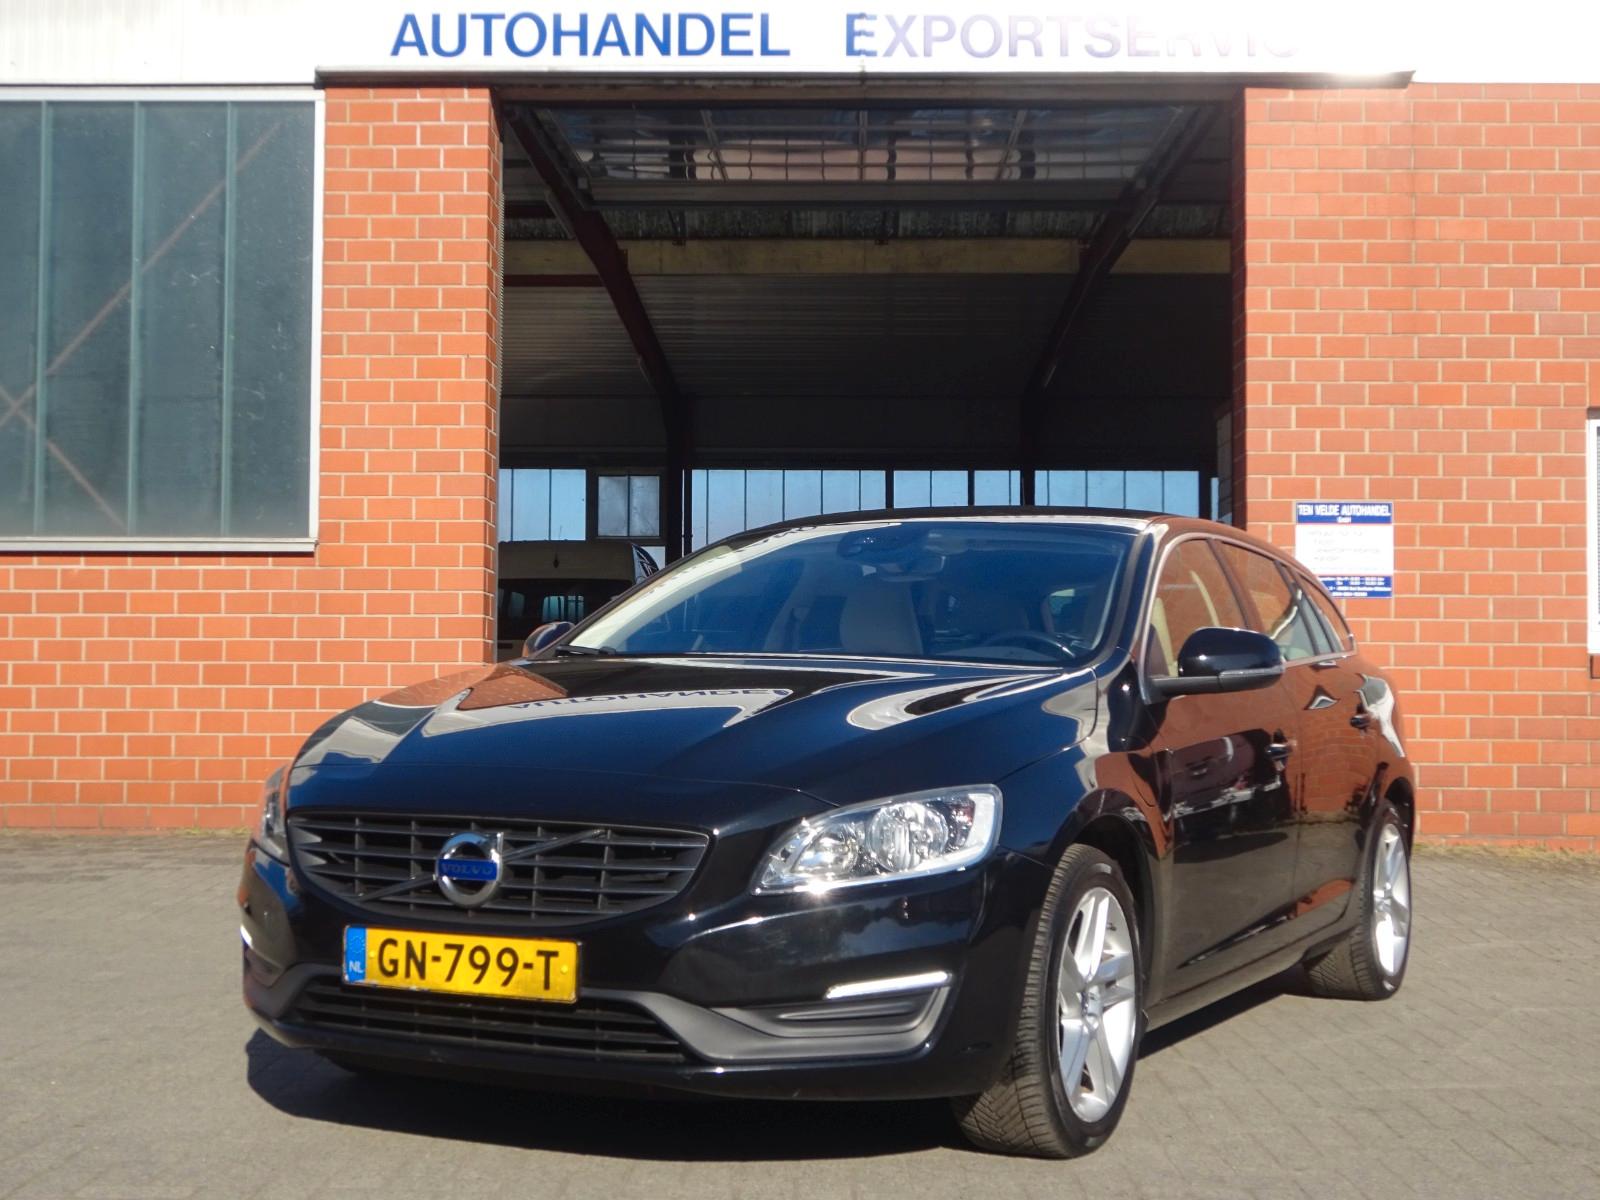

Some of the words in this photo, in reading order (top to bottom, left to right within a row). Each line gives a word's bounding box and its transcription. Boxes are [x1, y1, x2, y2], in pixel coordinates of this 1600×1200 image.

[391, 12, 790, 58] AUTOHANDEL
[1341, 505, 1391, 516] AUTOHANDEL
[440, 863, 494, 876] VOLVO
[349, 961, 364, 974] NL
[378, 938, 559, 990] GN-799-T
